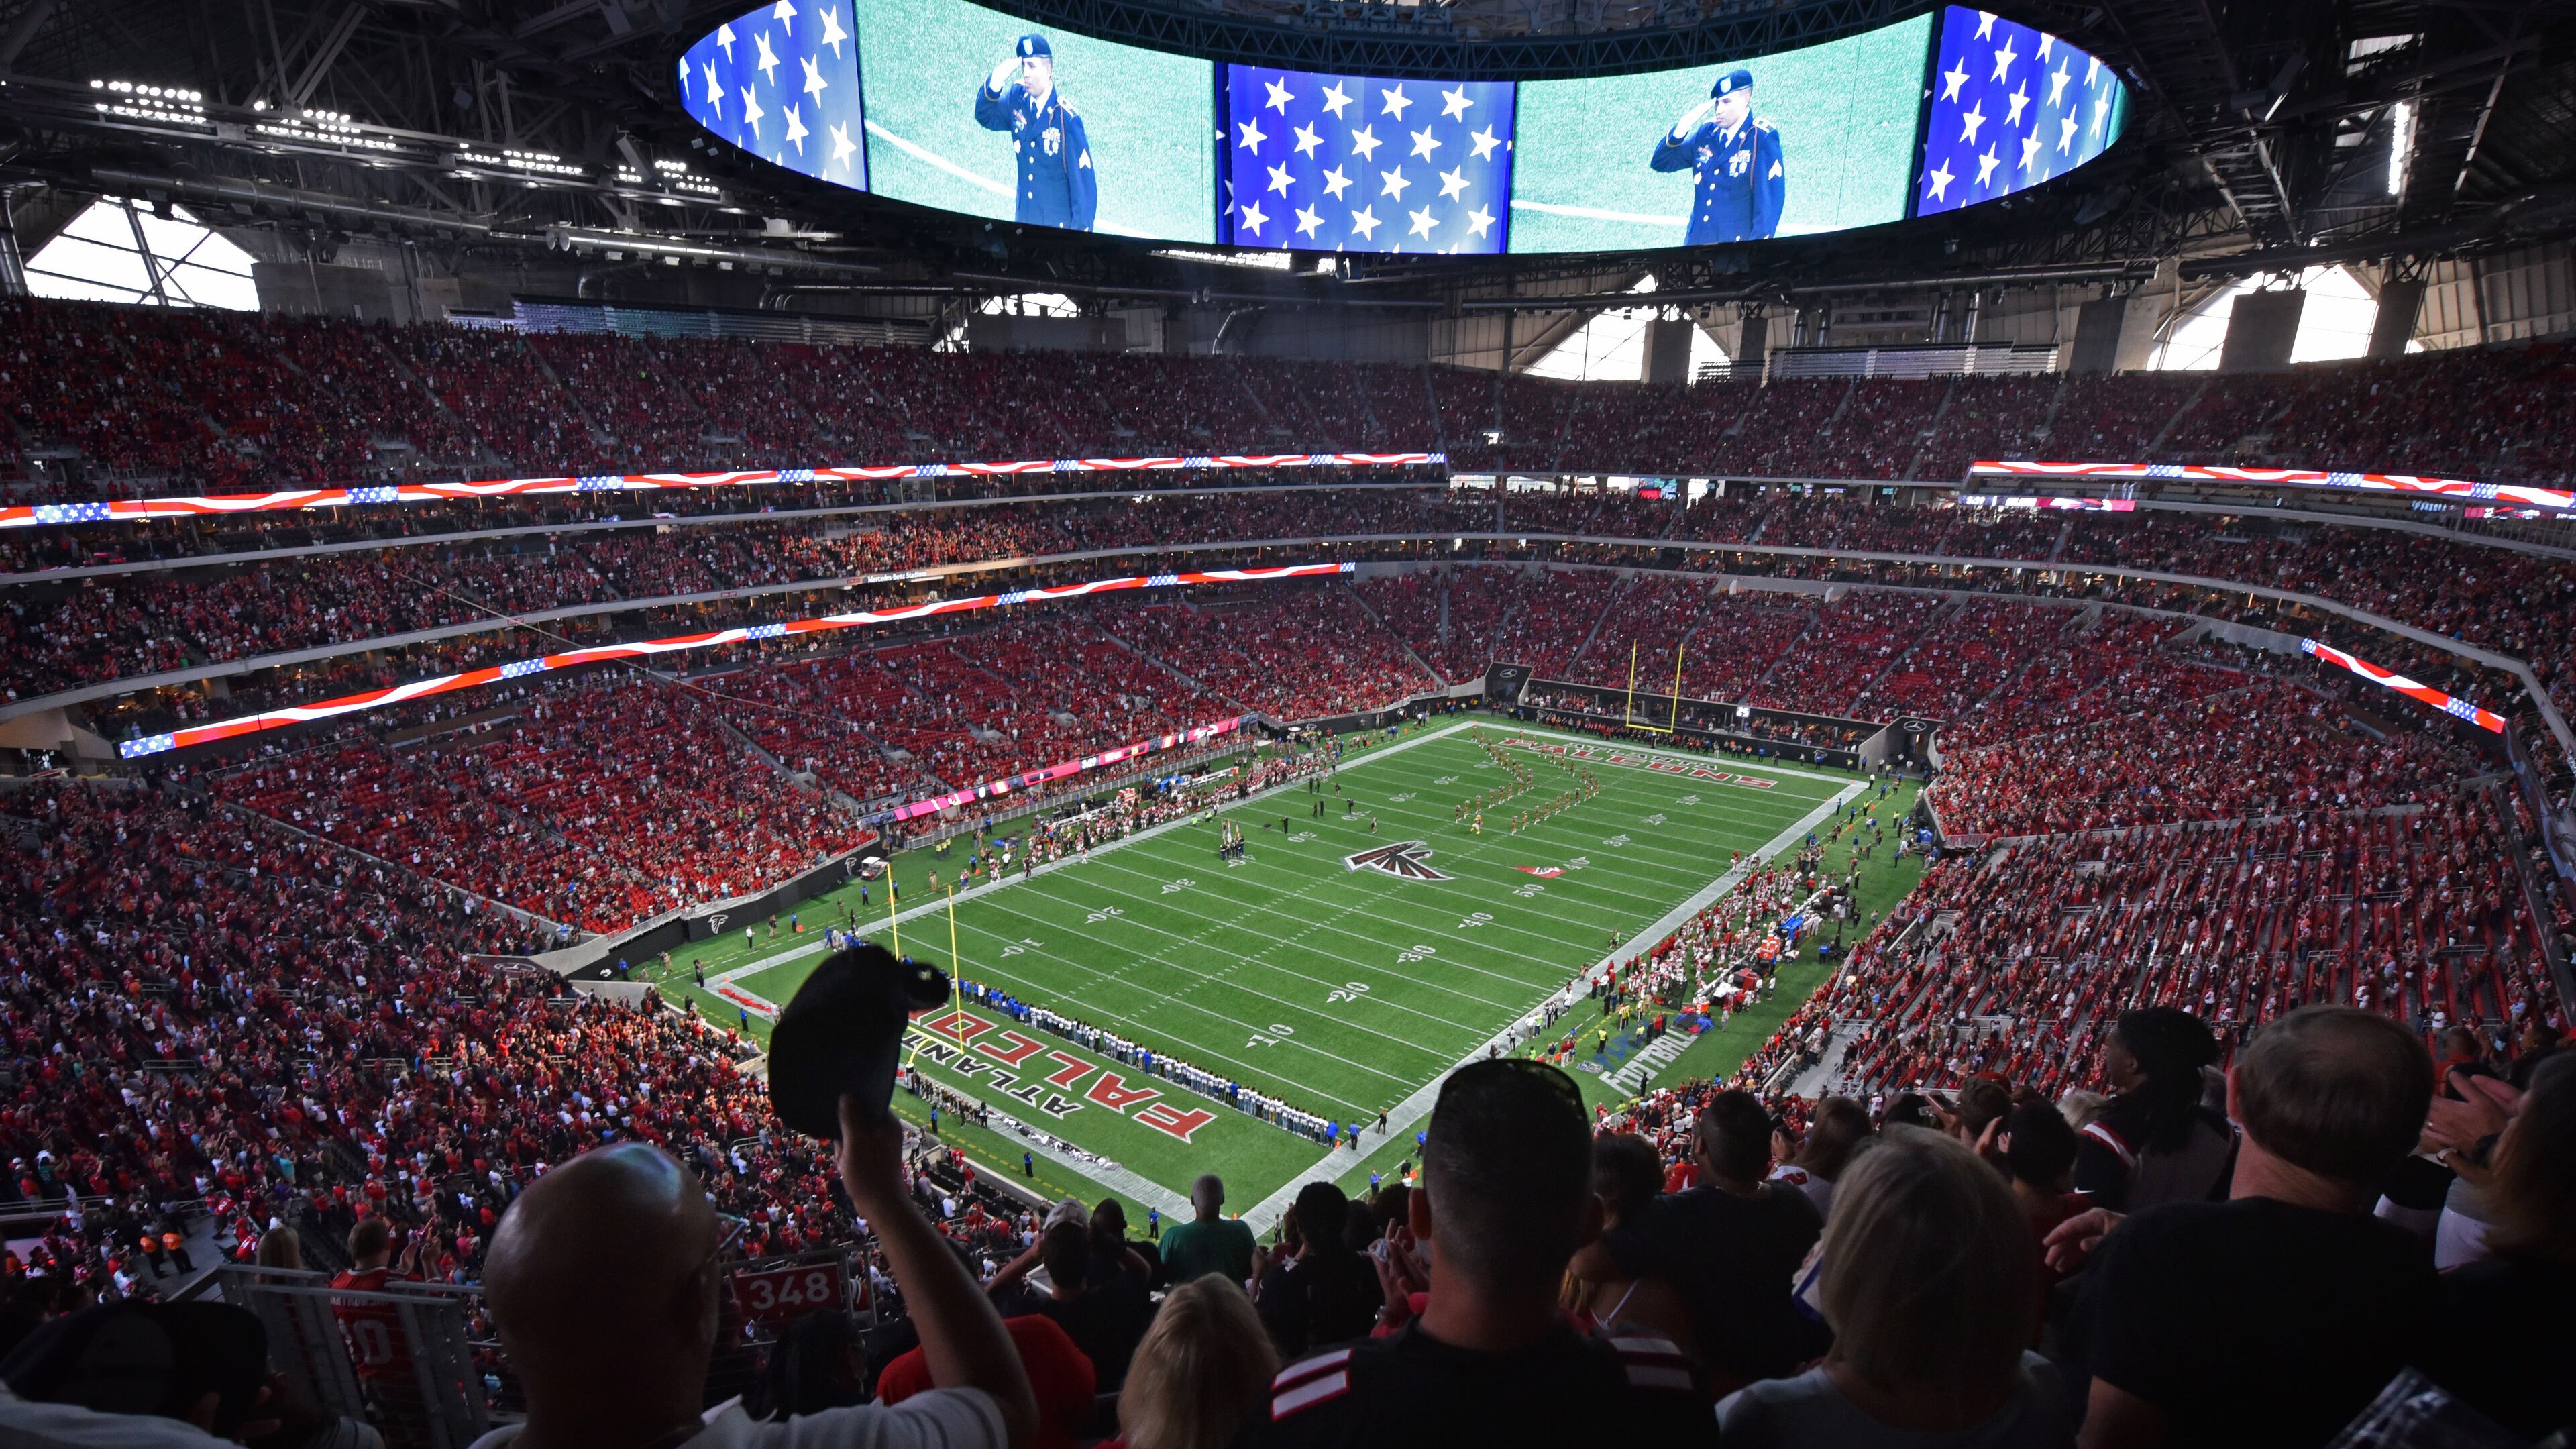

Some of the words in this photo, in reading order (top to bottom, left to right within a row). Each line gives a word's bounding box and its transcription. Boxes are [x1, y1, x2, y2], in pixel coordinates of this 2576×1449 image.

[867, 574, 906, 583] Mercedes-Benz
[1499, 738, 1779, 788] FALCONS
[1564, 742, 1717, 770] ATLANTA
[1162, 878, 1196, 894] 30
[1513, 883, 1544, 897] 50
[1087, 906, 1124, 923] 20
[1462, 912, 1494, 928] 40
[1004, 937, 1045, 956] 10
[1399, 945, 1436, 963] 30
[1330, 981, 1370, 1002] 20
[1250, 1024, 1295, 1048] 10
[908, 1003, 1218, 1144] FALCO
[1598, 1028, 1699, 1098] FOOTBALL
[901, 1033, 1085, 1120] ATLANT
[749, 1271, 831, 1310] 348
